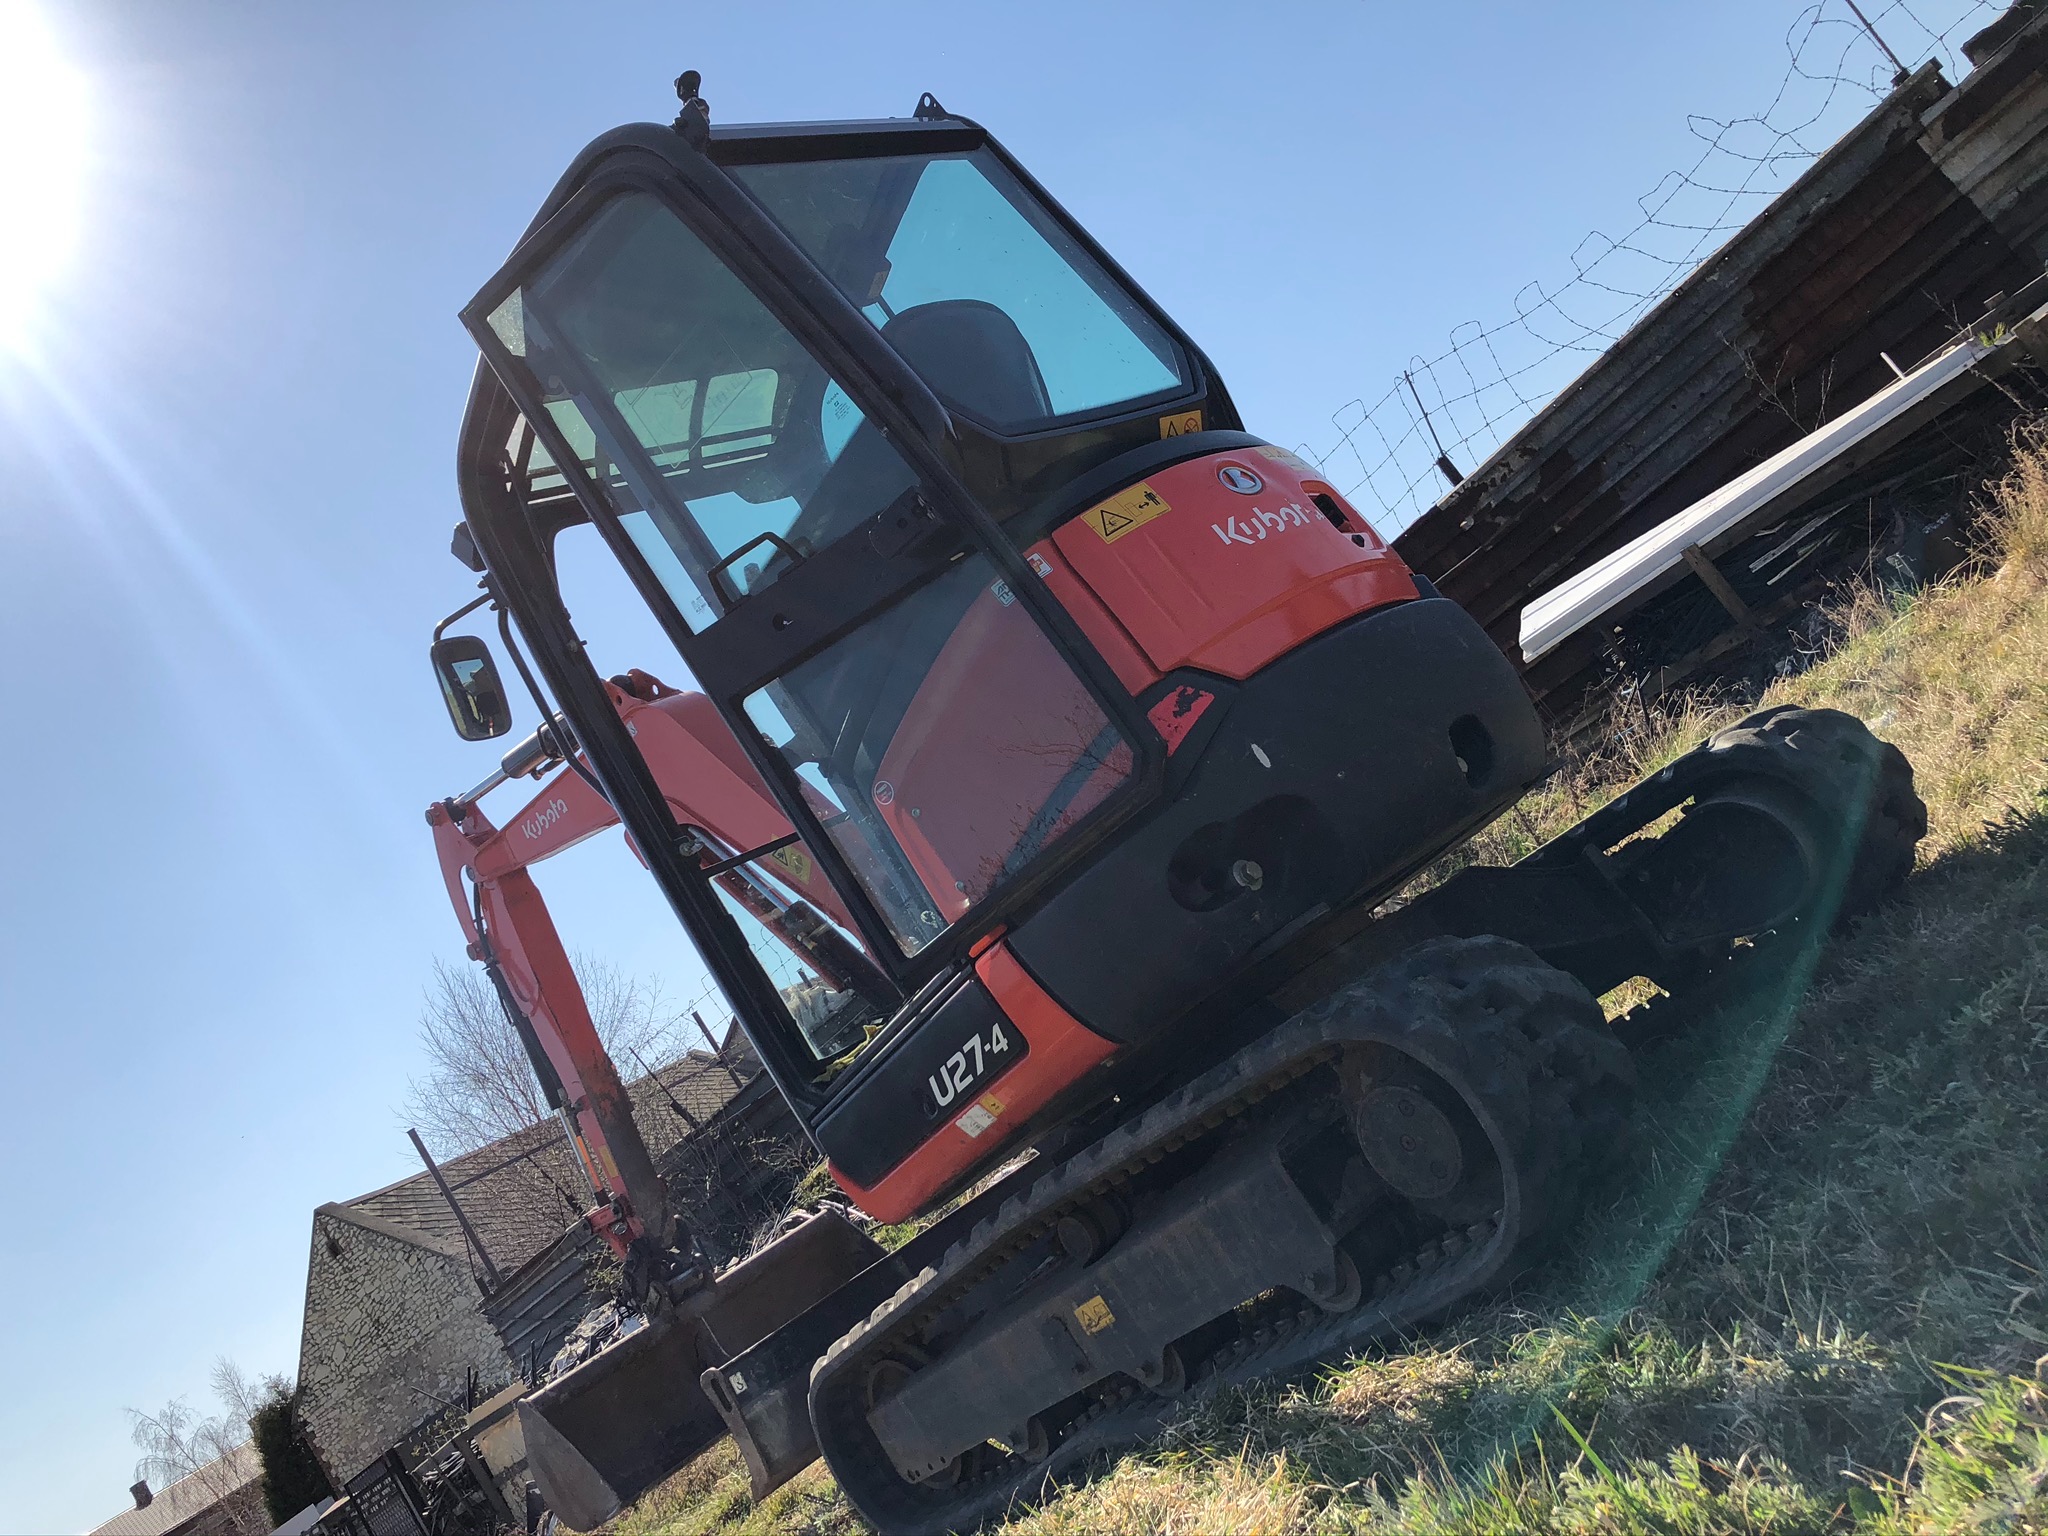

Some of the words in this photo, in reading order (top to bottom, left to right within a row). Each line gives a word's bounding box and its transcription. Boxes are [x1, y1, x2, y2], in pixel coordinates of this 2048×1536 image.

[1211, 501, 1325, 545] Kubot
[521, 798, 568, 839] Kubota
[928, 1023, 1009, 1107] U27-4
